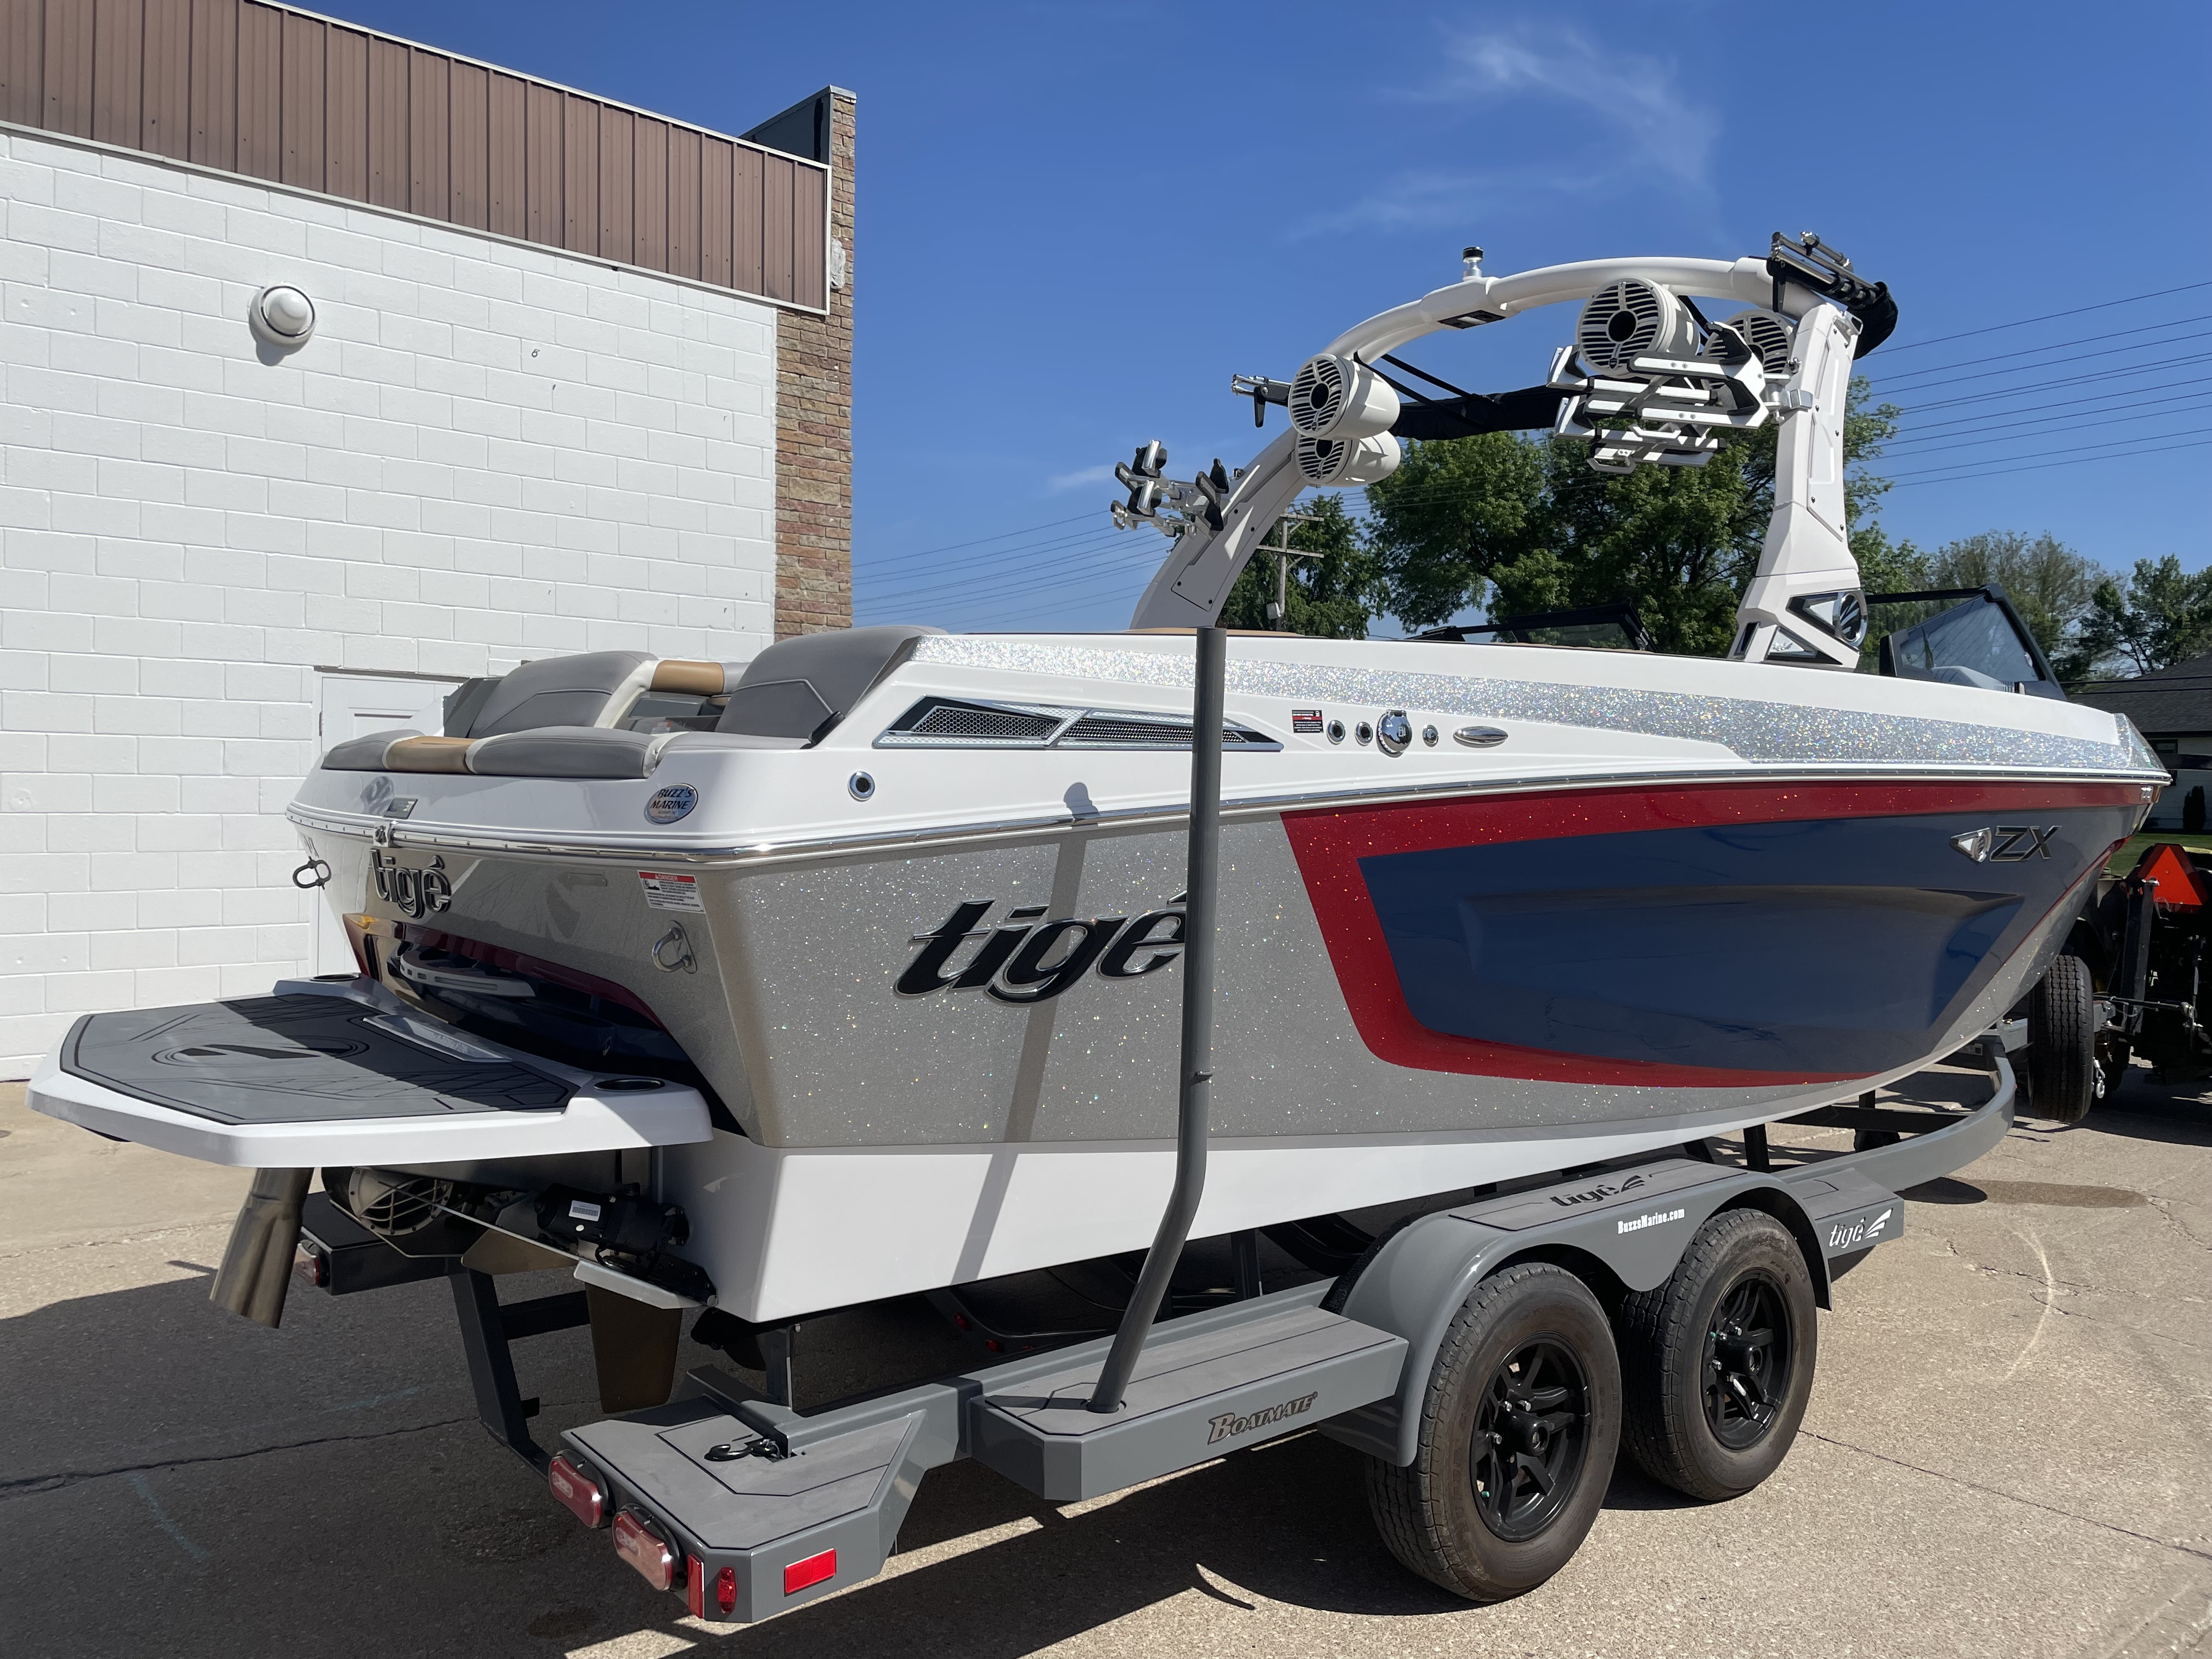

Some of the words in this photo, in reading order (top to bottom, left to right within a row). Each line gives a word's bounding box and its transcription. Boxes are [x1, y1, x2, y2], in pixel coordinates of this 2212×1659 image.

[657, 787, 694, 799] BUZZ'S
[650, 800, 690, 809] MARINE
[1989, 825, 2062, 862] ZX
[1617, 1209, 1685, 1234] BuzzsMarine.com
